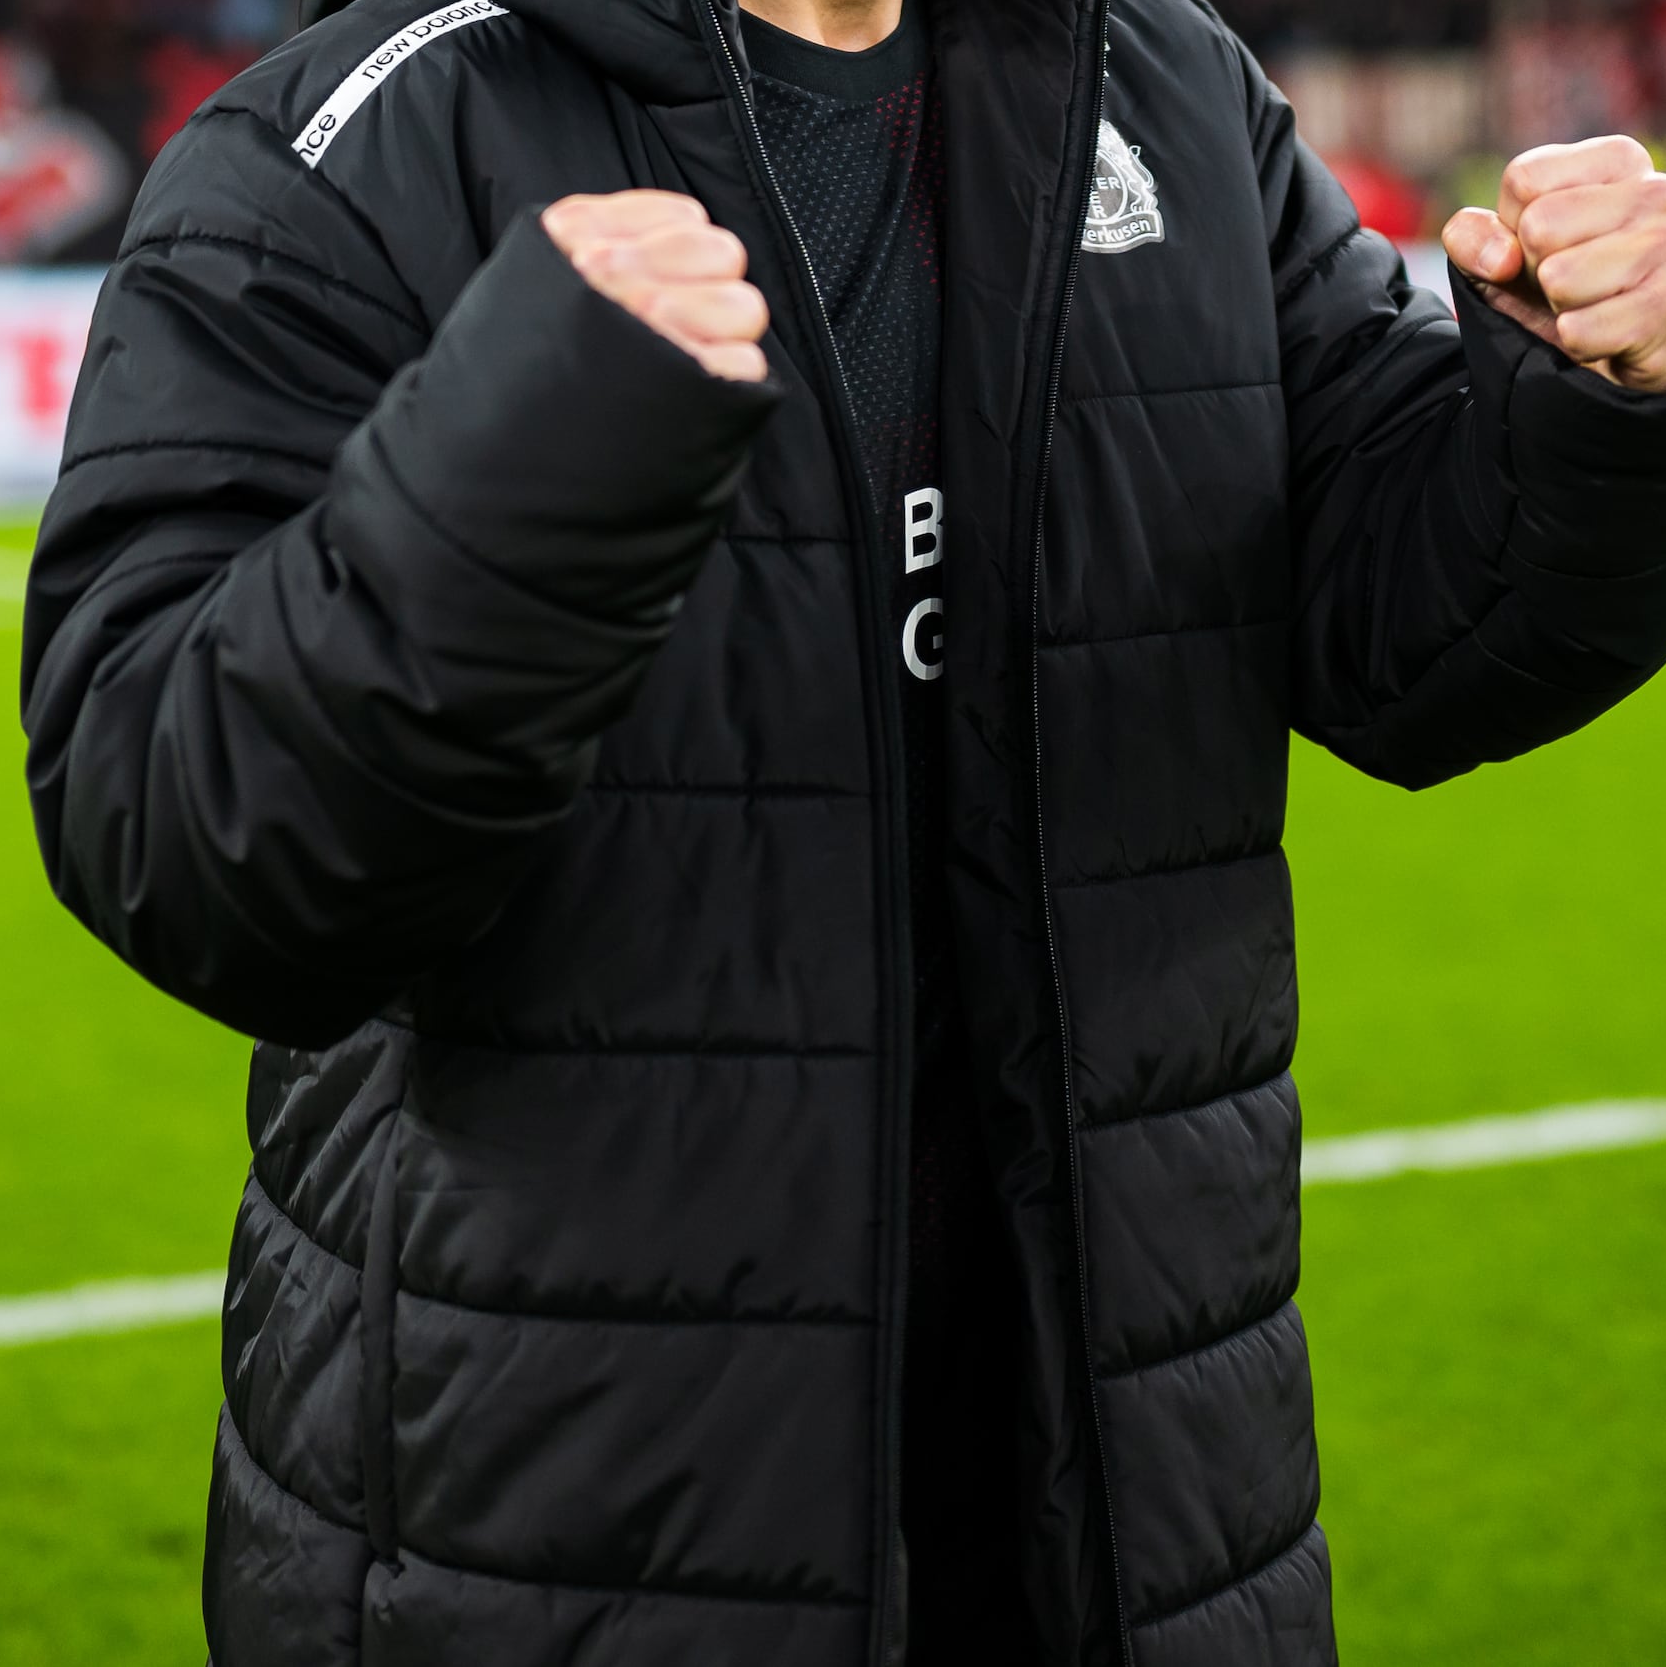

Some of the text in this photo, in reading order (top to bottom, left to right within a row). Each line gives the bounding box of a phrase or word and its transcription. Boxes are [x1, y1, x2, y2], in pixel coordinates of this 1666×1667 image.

[362, 37, 410, 79] new
[406, 0, 498, 39] balanc
[1083, 219, 1152, 243] erkusen
